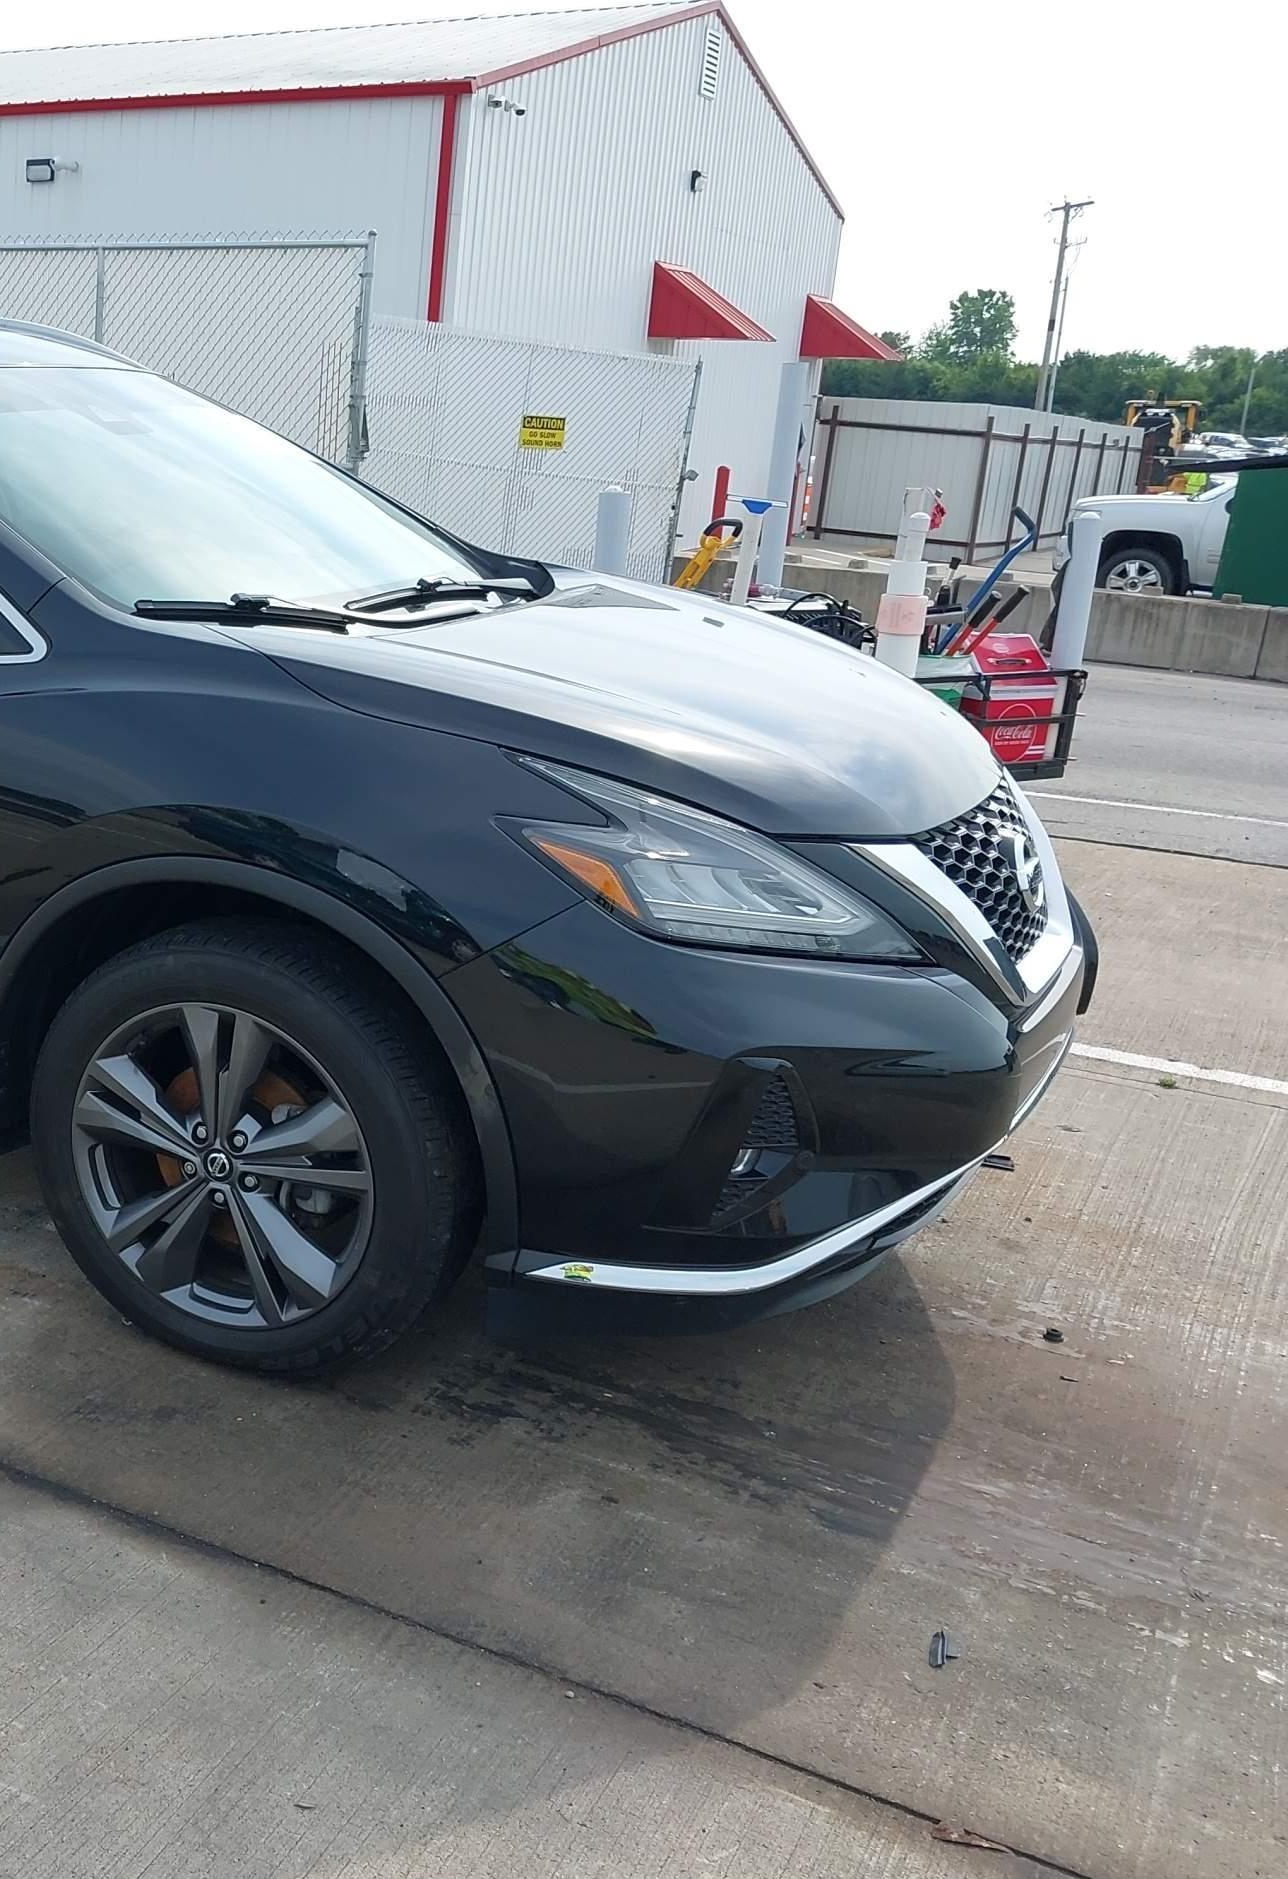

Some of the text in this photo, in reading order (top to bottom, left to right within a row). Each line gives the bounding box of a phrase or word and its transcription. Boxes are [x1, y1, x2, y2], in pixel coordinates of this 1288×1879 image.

[524, 417, 564, 430] CAUTION
[528, 431, 557, 439] GO SLOW
